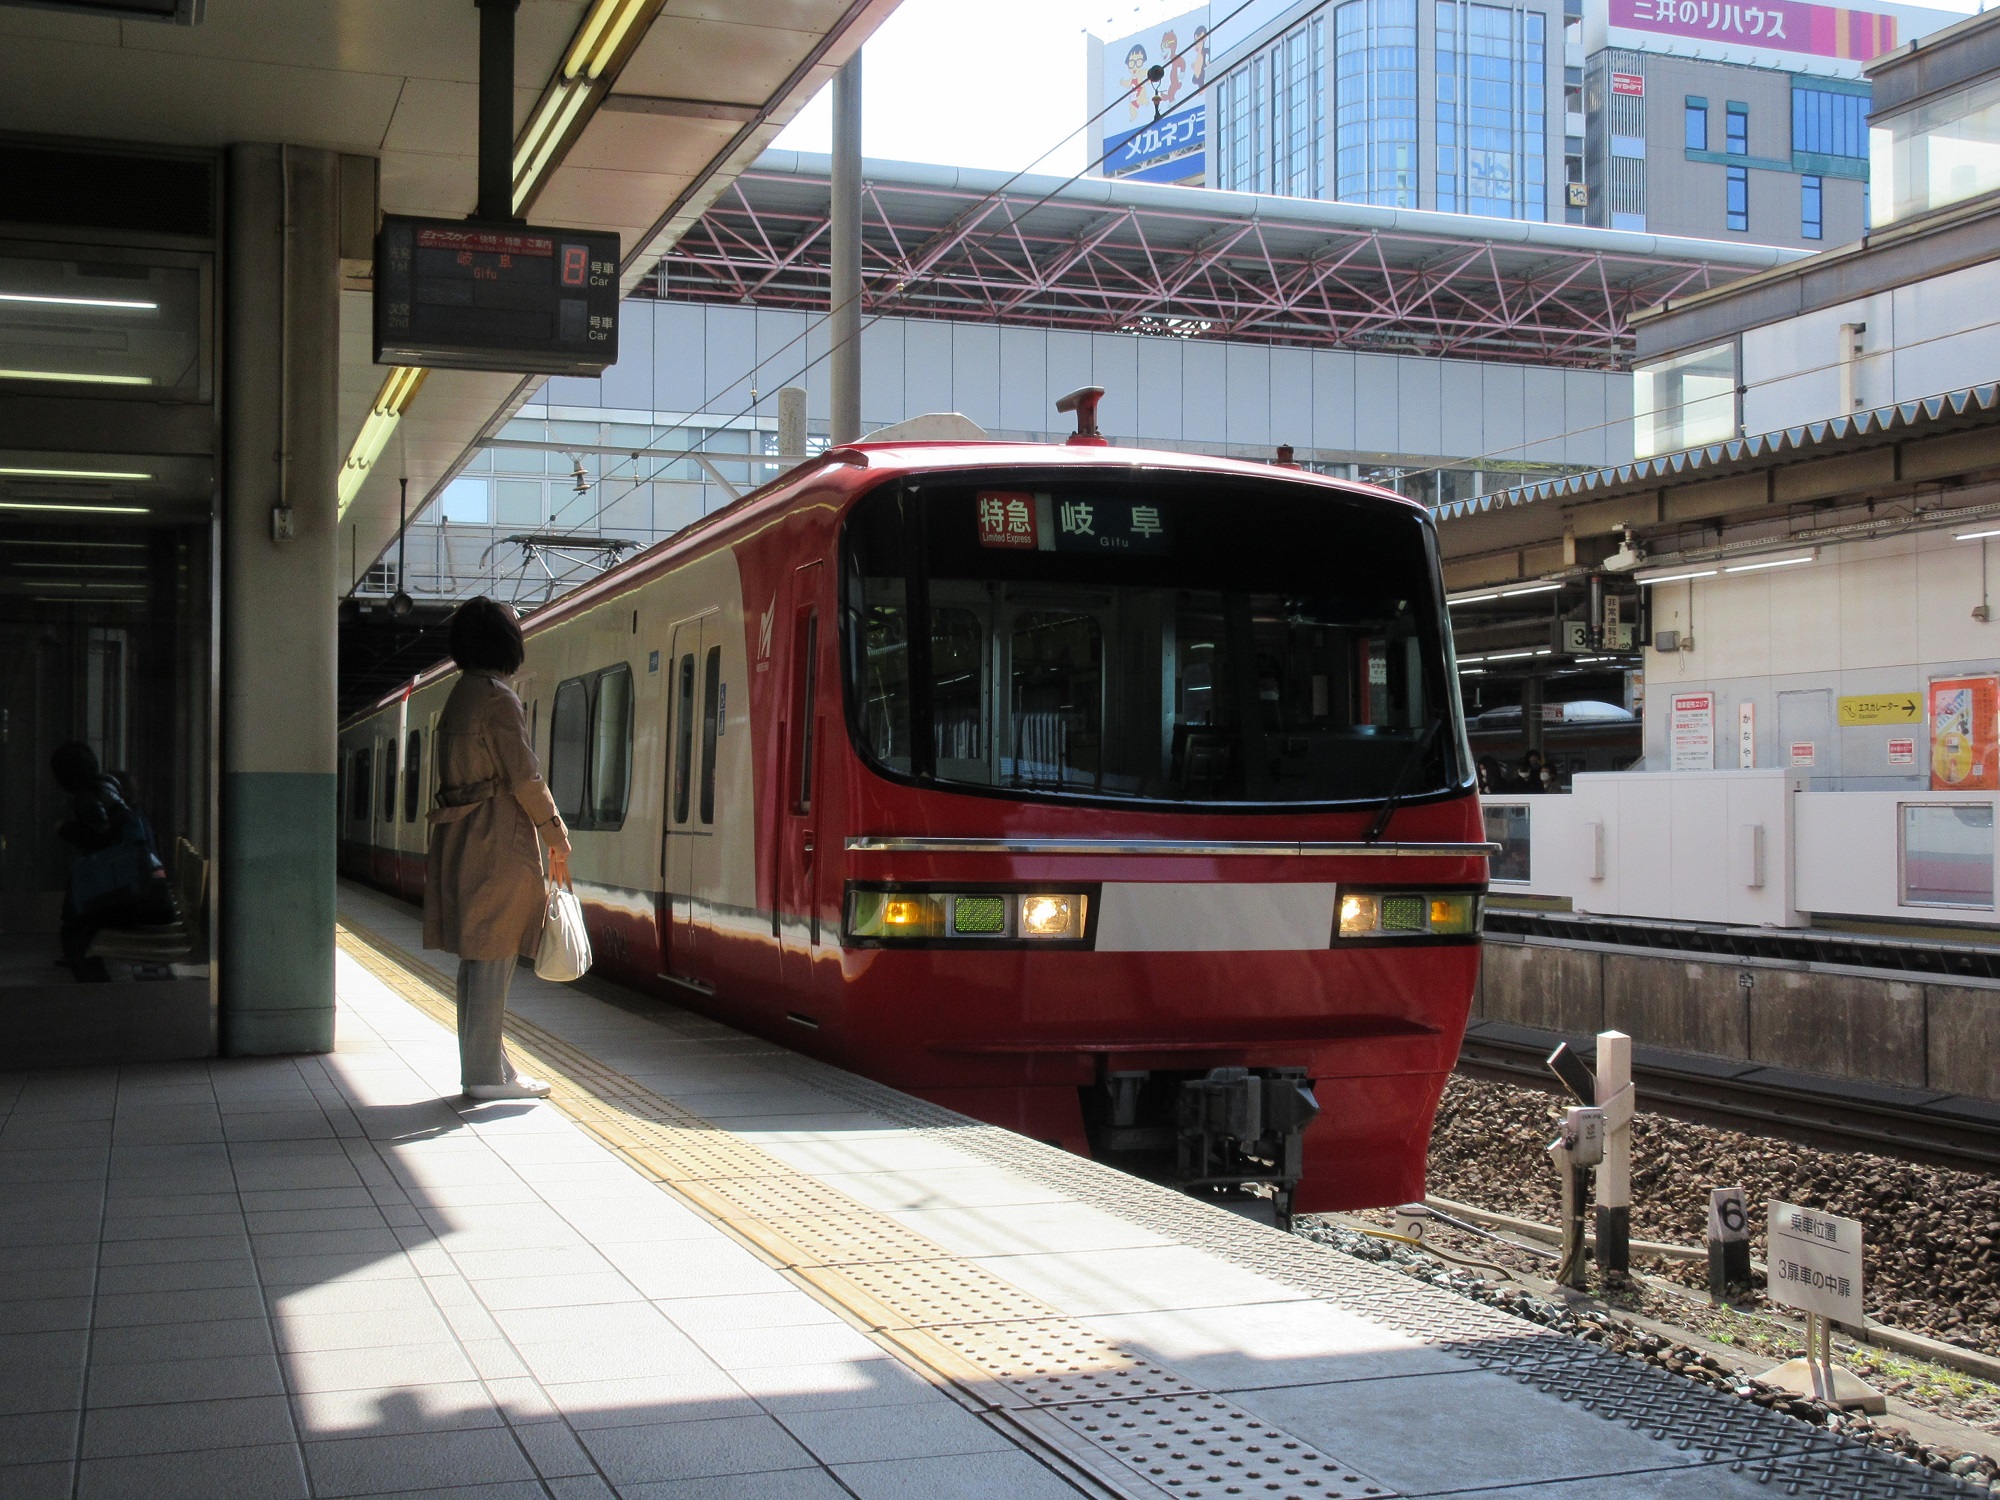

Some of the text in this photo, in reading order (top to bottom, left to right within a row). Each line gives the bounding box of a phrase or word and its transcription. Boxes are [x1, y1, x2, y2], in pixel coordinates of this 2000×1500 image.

[1633, 0, 1786, 39] 三井のリハウス
[474, 266, 497, 280] Gifu
[563, 248, 587, 285] 8
[590, 261, 614, 275] 号車
[590, 276, 609, 286] Car
[589, 315, 613, 329] 号車
[588, 330, 608, 341] Car
[980, 497, 1032, 533] 特急
[982, 532, 1032, 545] Limited Express
[1100, 536, 1129, 548] Gifu
[1607, 597, 1617, 646] 非常通報灯
[1574, 628, 1586, 646] 3
[1858, 702, 1899, 712] エスカレーター
[1722, 1197, 1745, 1232] 6
[1790, 1213, 1837, 1243] 乗車位置
[1778, 1259, 1851, 1298] 3扉車の中扉
